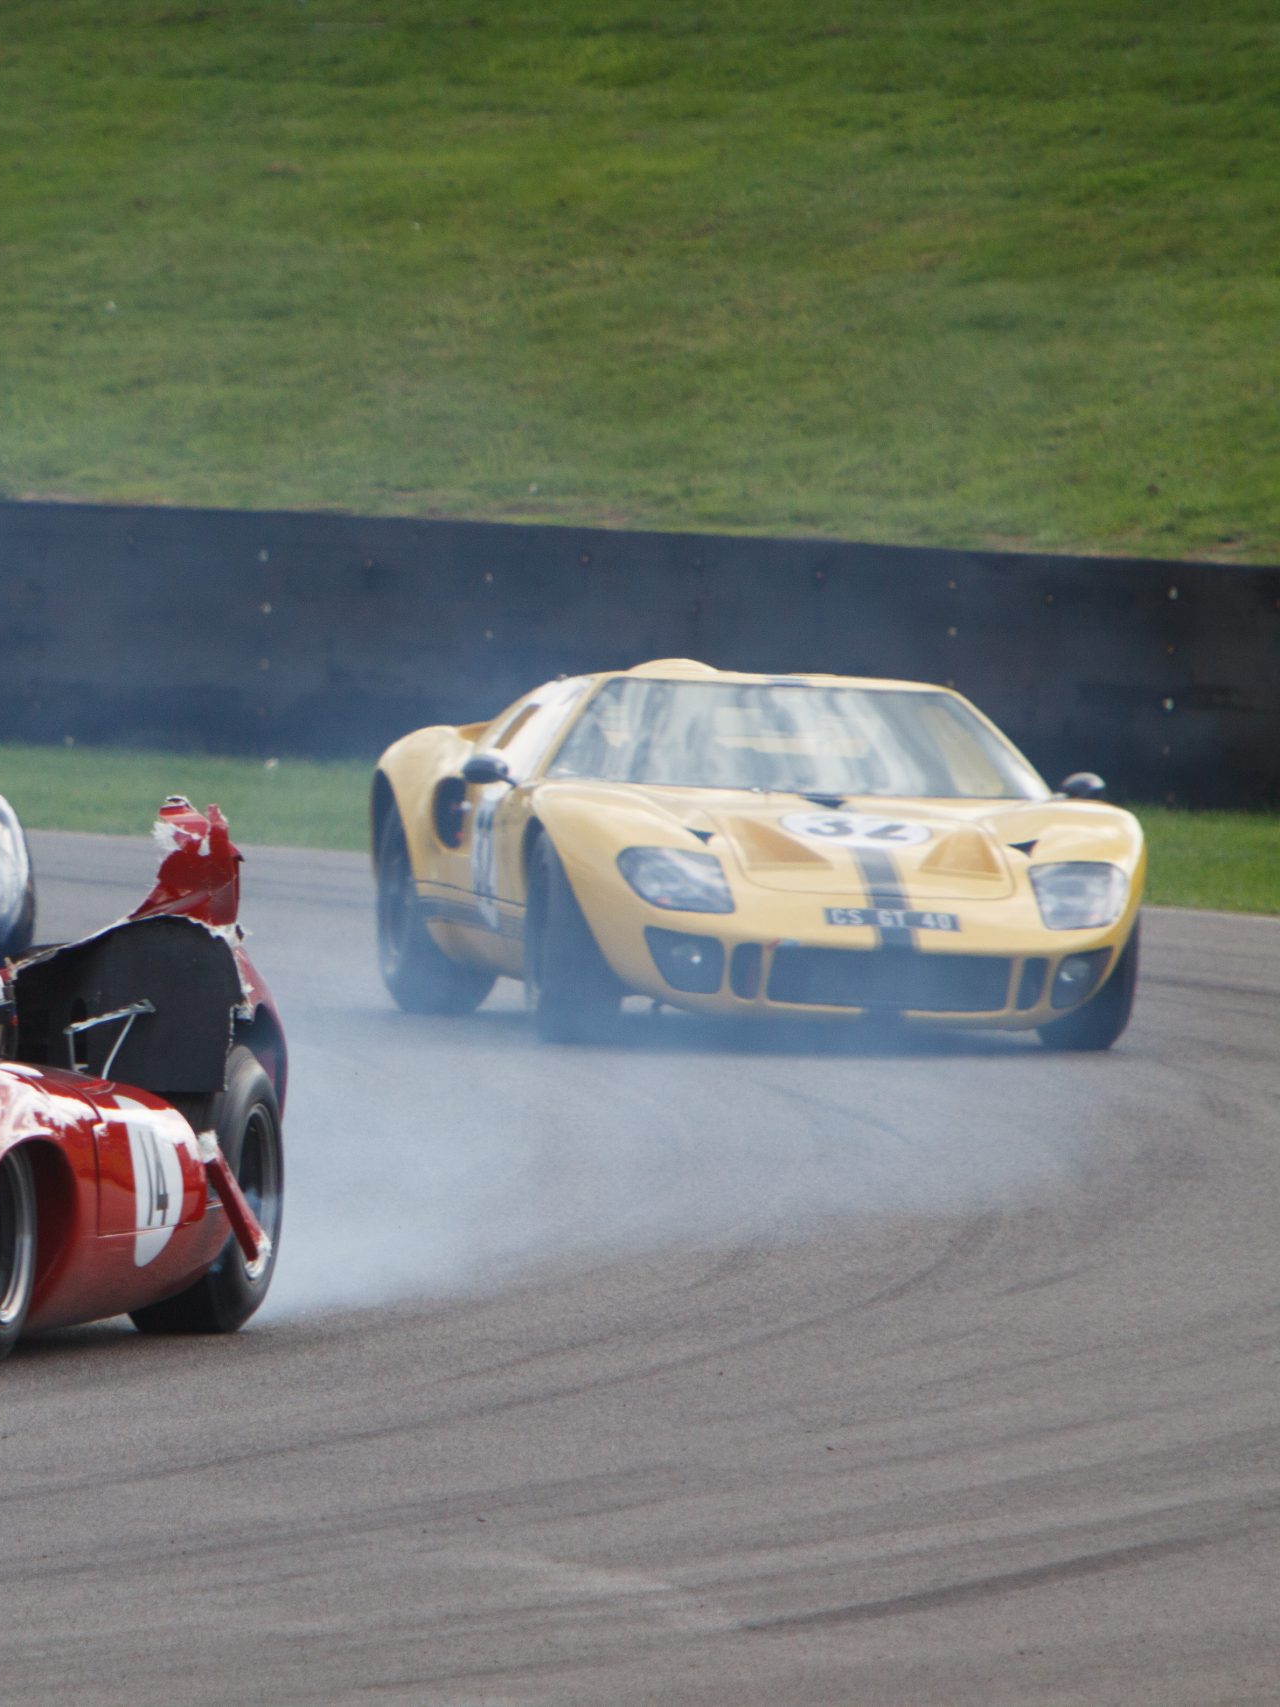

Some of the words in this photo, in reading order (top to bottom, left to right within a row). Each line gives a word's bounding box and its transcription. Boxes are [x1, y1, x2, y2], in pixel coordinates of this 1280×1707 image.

[806, 817, 909, 841] 32
[831, 908, 864, 925] CS
[877, 909, 907, 927] GT
[921, 913, 952, 930] 40
[138, 1130, 169, 1227] 14
